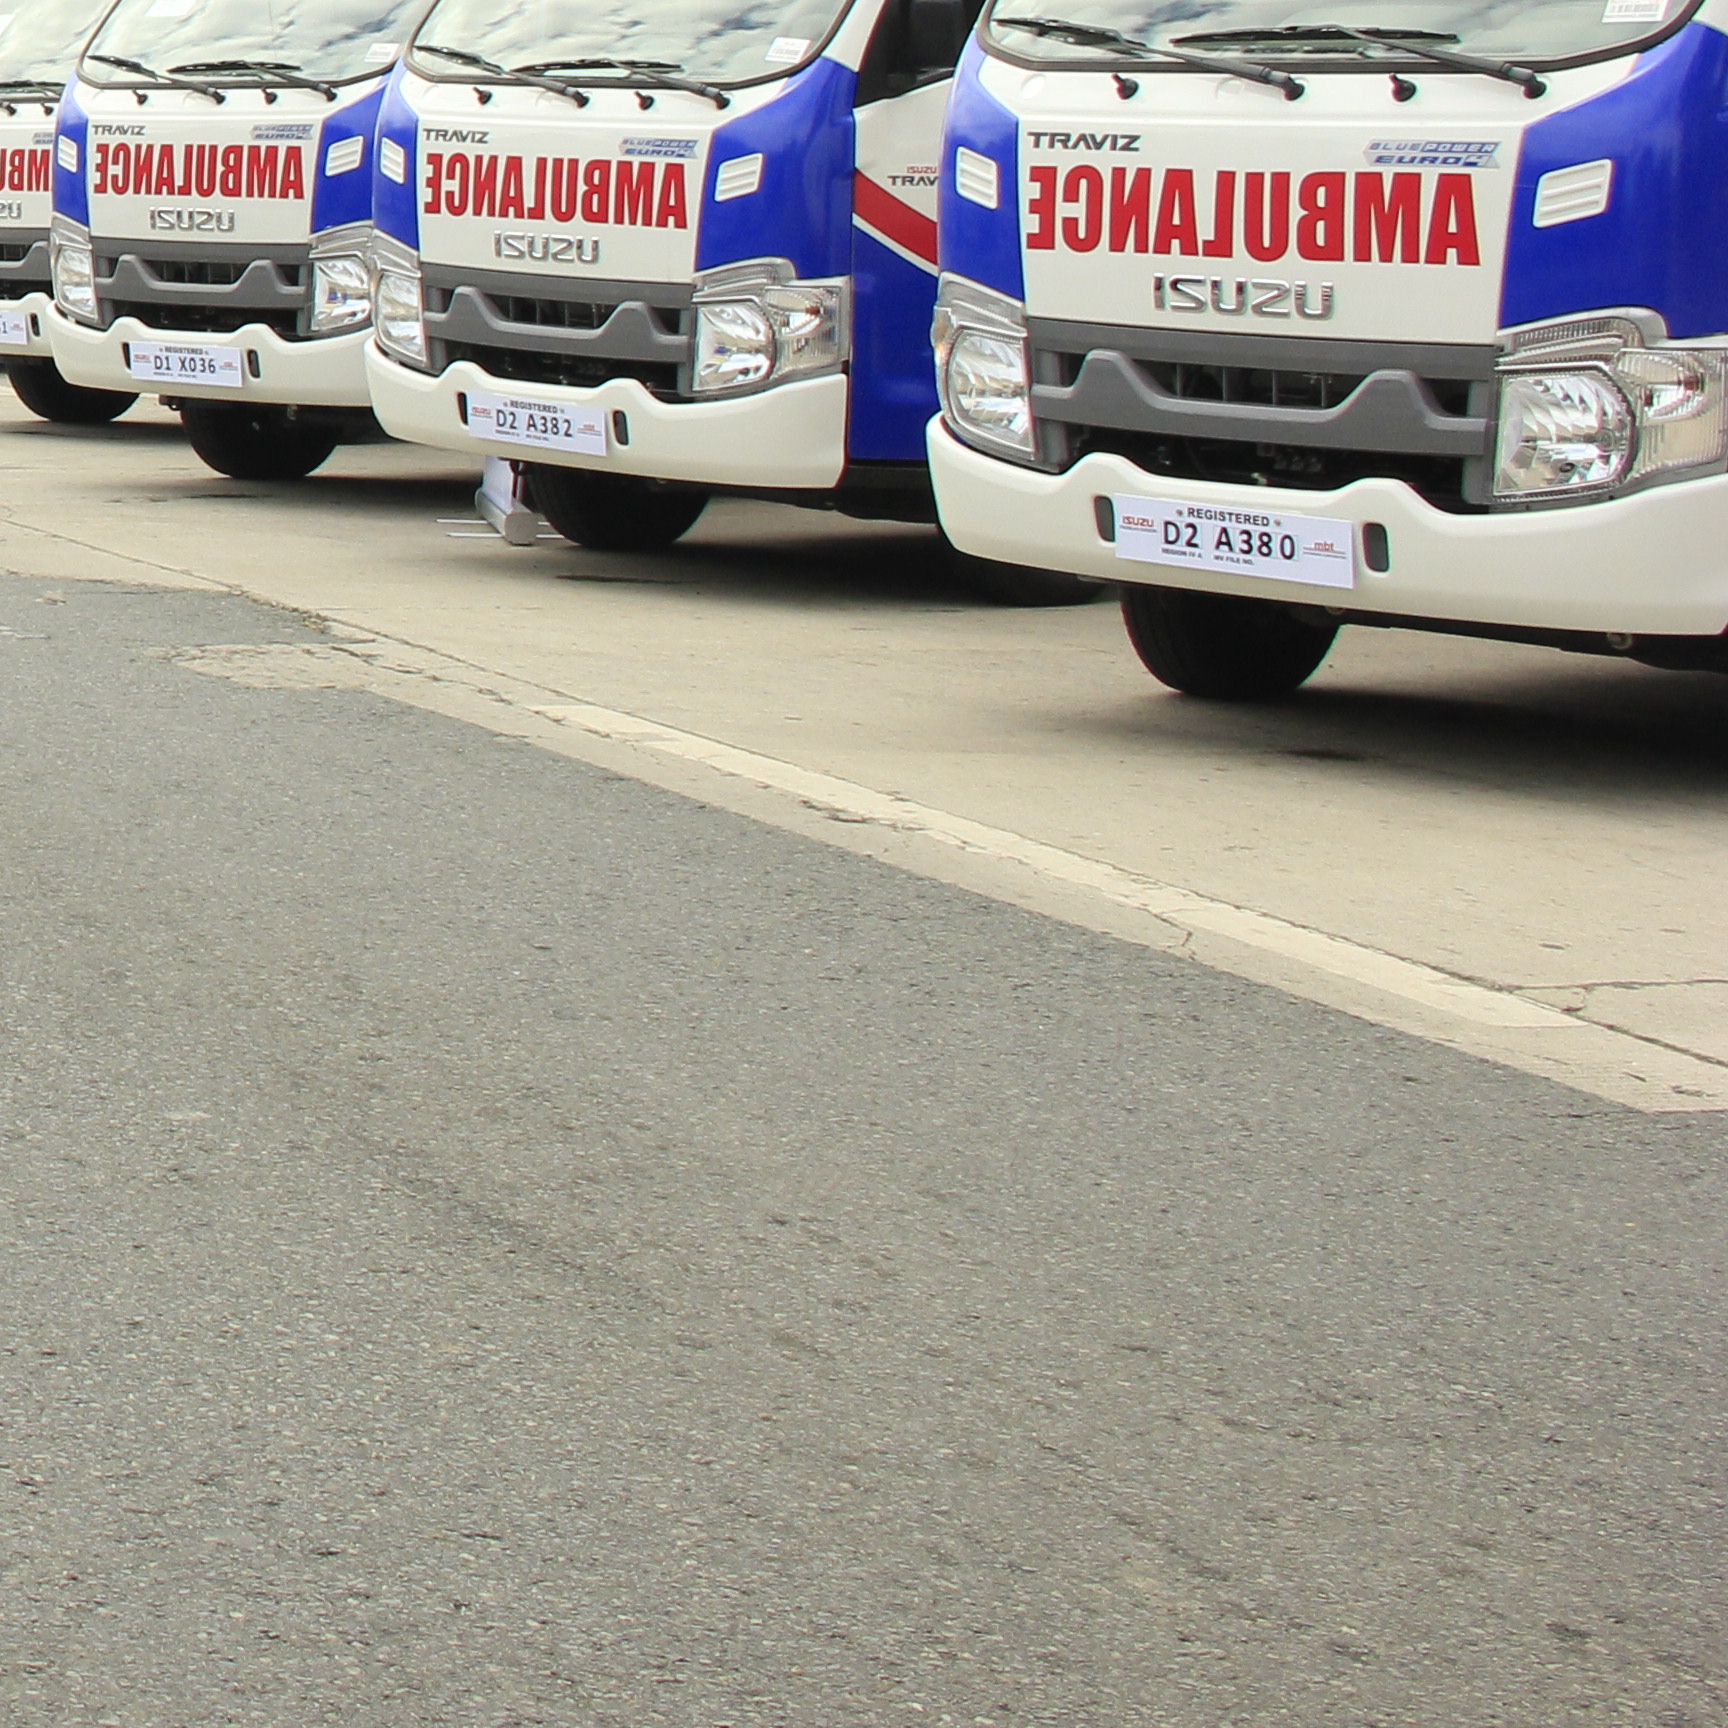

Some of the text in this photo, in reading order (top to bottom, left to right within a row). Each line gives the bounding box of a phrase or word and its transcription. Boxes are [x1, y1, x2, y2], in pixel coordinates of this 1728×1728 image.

[92, 124, 145, 136] TRAVIZ
[423, 129, 489, 144] TRAVIZ
[1027, 132, 1141, 152] TRAVIZ
[907, 166, 937, 174] ISUZU
[887, 175, 939, 186] TRAV
[149, 206, 236, 231] ISUZU
[493, 230, 599, 264] ISUZU
[1153, 272, 1334, 320] ISUZU
[154, 355, 216, 373] D1 X036
[509, 400, 558, 413] REGISTERED
[496, 410, 518, 429] D2
[526, 414, 572, 437] A382
[1122, 516, 1154, 528] ISUZU
[1187, 507, 1271, 527] REGISTERED
[1162, 520, 1296, 560] D2 A380
[1313, 540, 1334, 551] mbt
